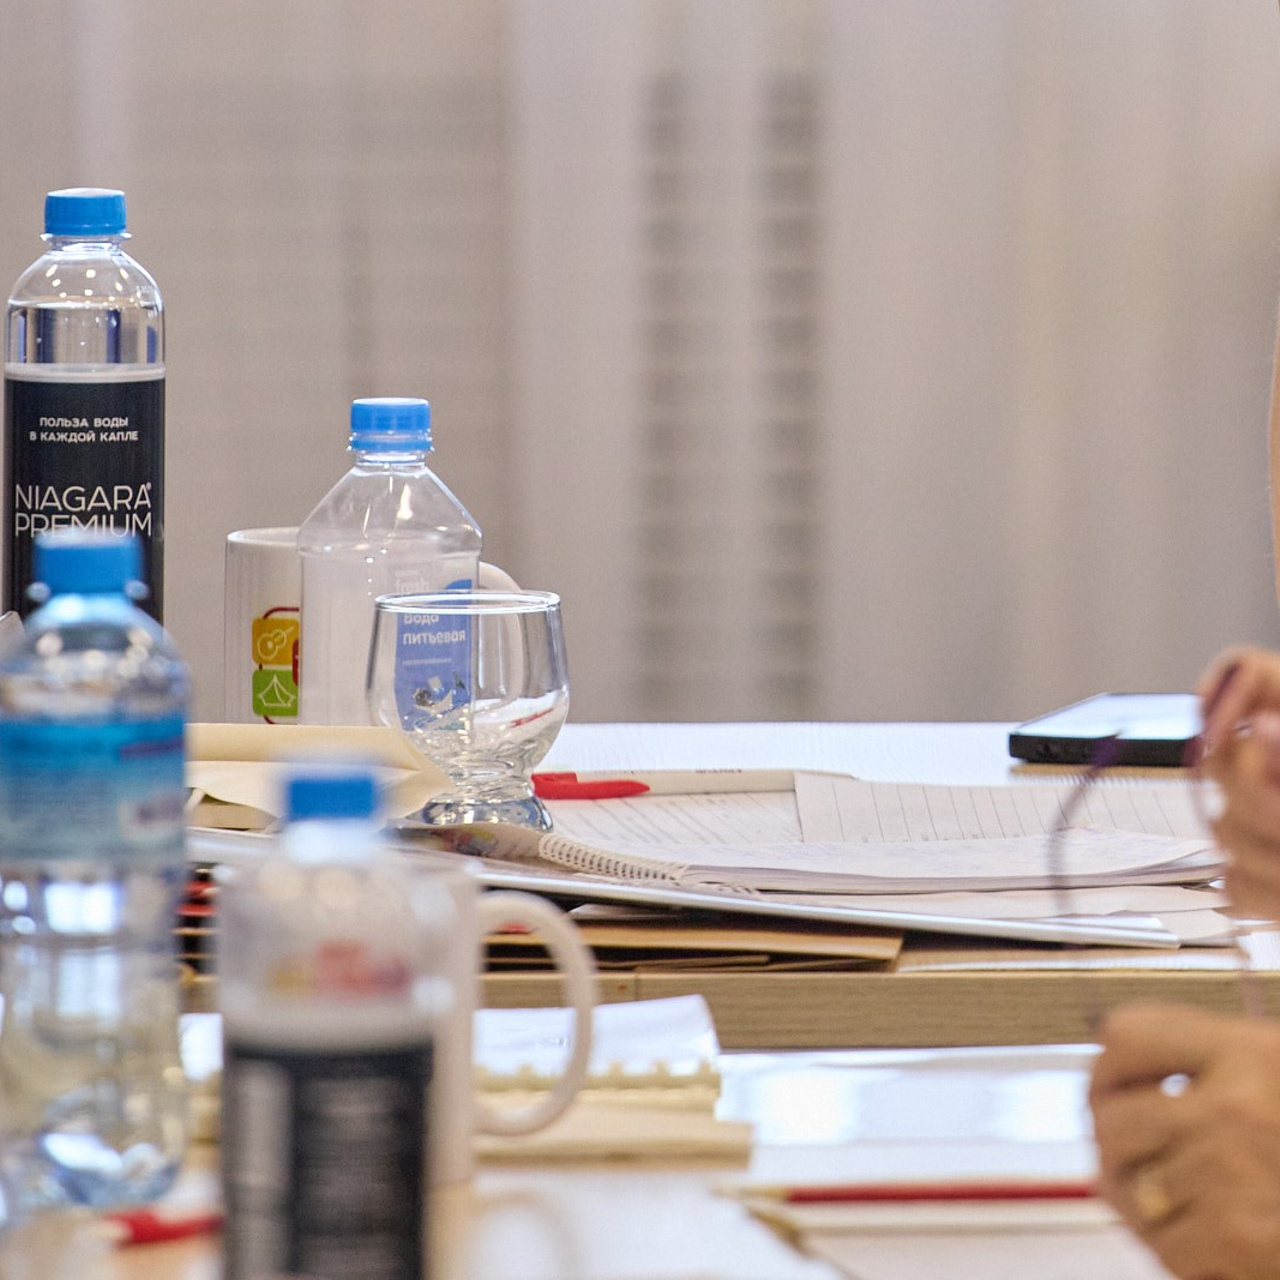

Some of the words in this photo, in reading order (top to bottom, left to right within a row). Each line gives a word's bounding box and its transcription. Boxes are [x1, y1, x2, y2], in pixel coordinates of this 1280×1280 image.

[39, 417, 89, 427] ПОЛЬЗА
[93, 417, 129, 428] ВОДЫ
[29, 431, 37, 441] В
[40, 431, 96, 443] КАЖДОЙ
[100, 431, 139, 442] КАПЛЕ
[15, 483, 152, 511] NIAGARA
[403, 630, 466, 646] питьевая
